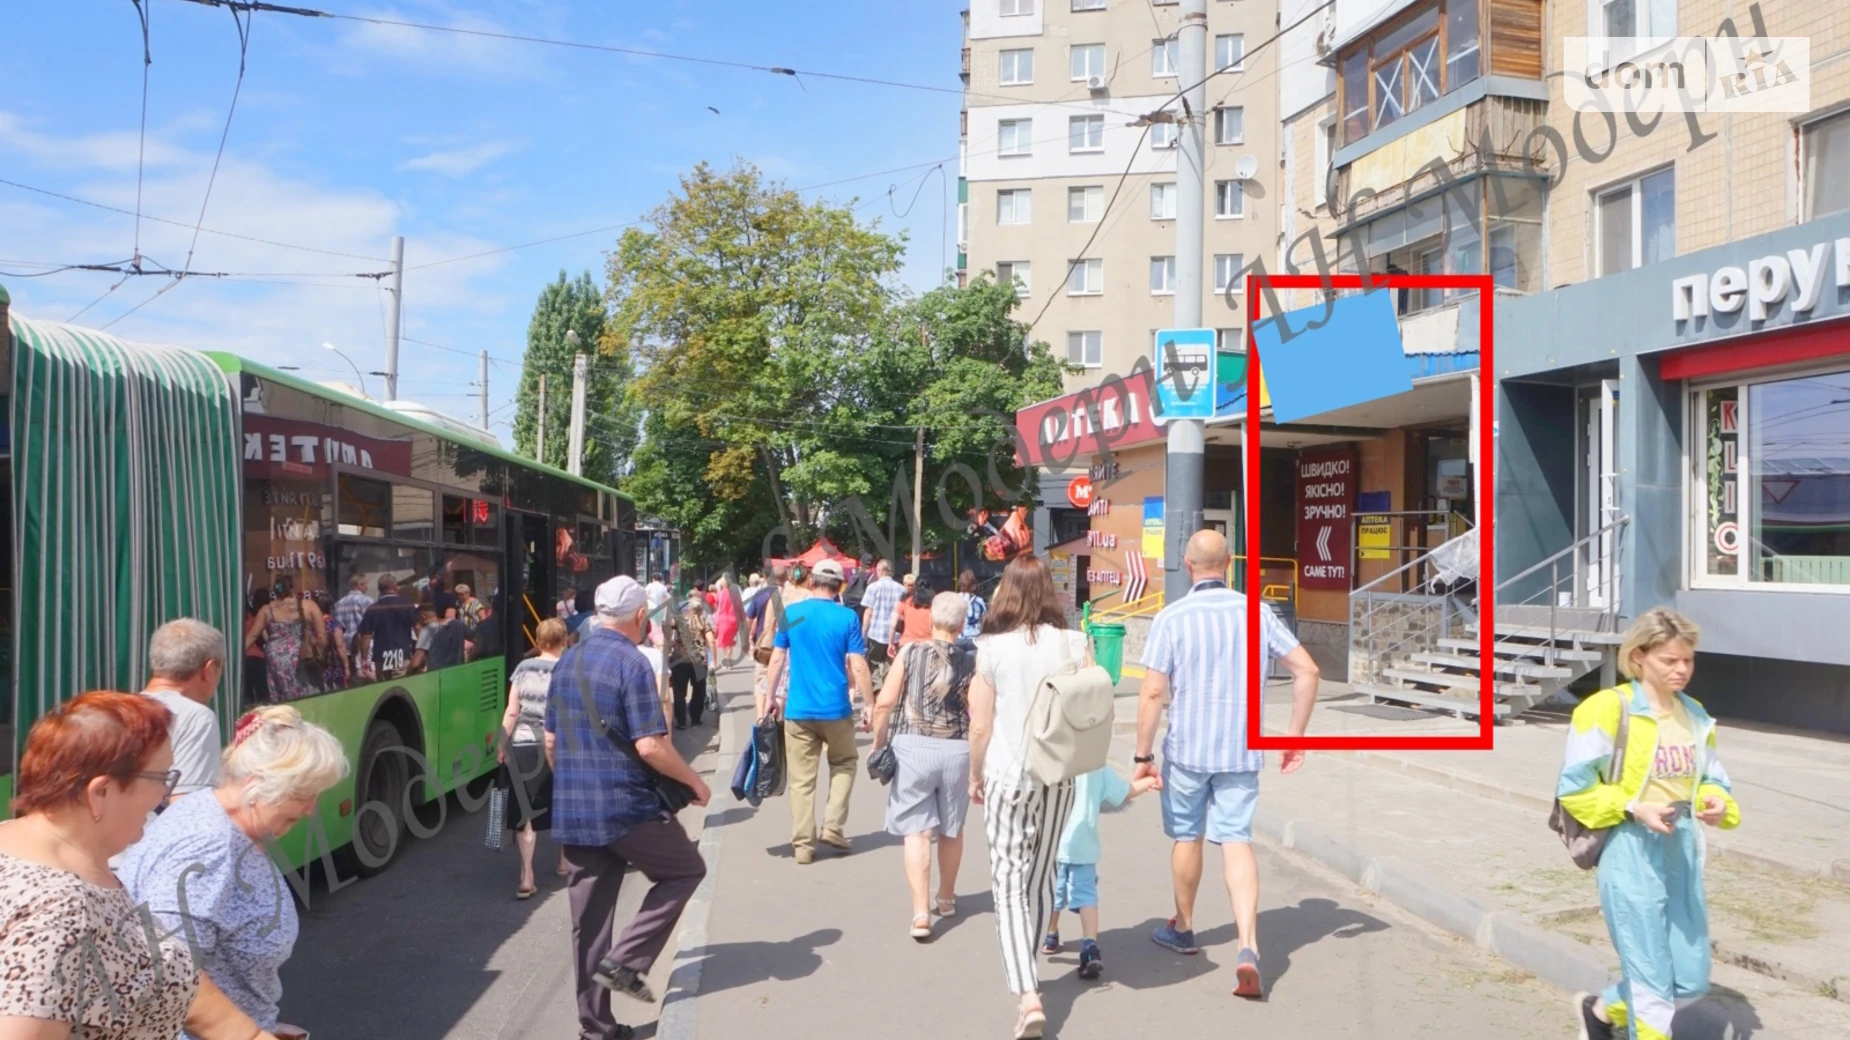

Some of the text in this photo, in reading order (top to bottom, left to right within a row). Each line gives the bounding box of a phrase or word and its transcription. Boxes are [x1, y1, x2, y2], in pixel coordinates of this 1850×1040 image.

[1301, 460, 1350, 478] ШВИДКО!
[1304, 482, 1345, 499] ЯКІСНО!
[1304, 504, 1346, 520] ЗРУЧНО!
[1361, 514, 1389, 523] АПТЕКА
[1304, 566, 1345, 578] САМЕ ТУТ!
